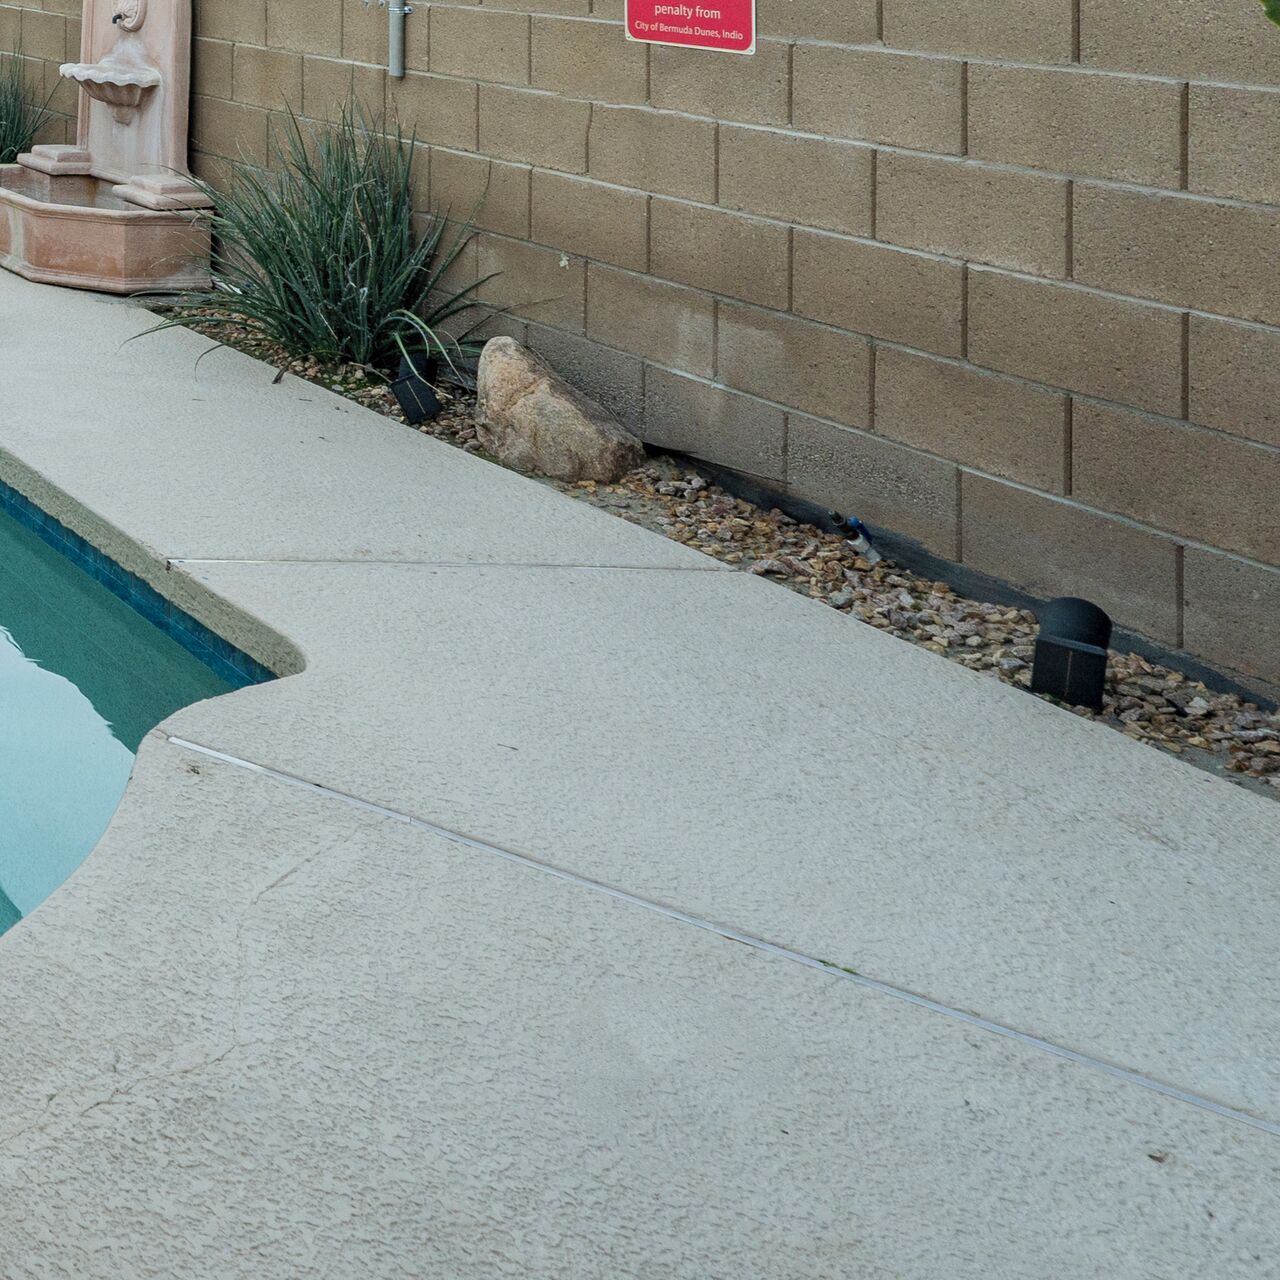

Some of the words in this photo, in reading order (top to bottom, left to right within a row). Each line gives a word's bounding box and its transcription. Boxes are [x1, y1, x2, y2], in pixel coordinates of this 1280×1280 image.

[654, 4, 693, 19] penalty
[695, 5, 721, 19] from
[635, 20, 649, 32] City
[650, 22, 658, 31] of
[659, 23, 693, 35] Bermuda
[694, 26, 721, 38] Dunes,
[722, 29, 744, 40] Indio
